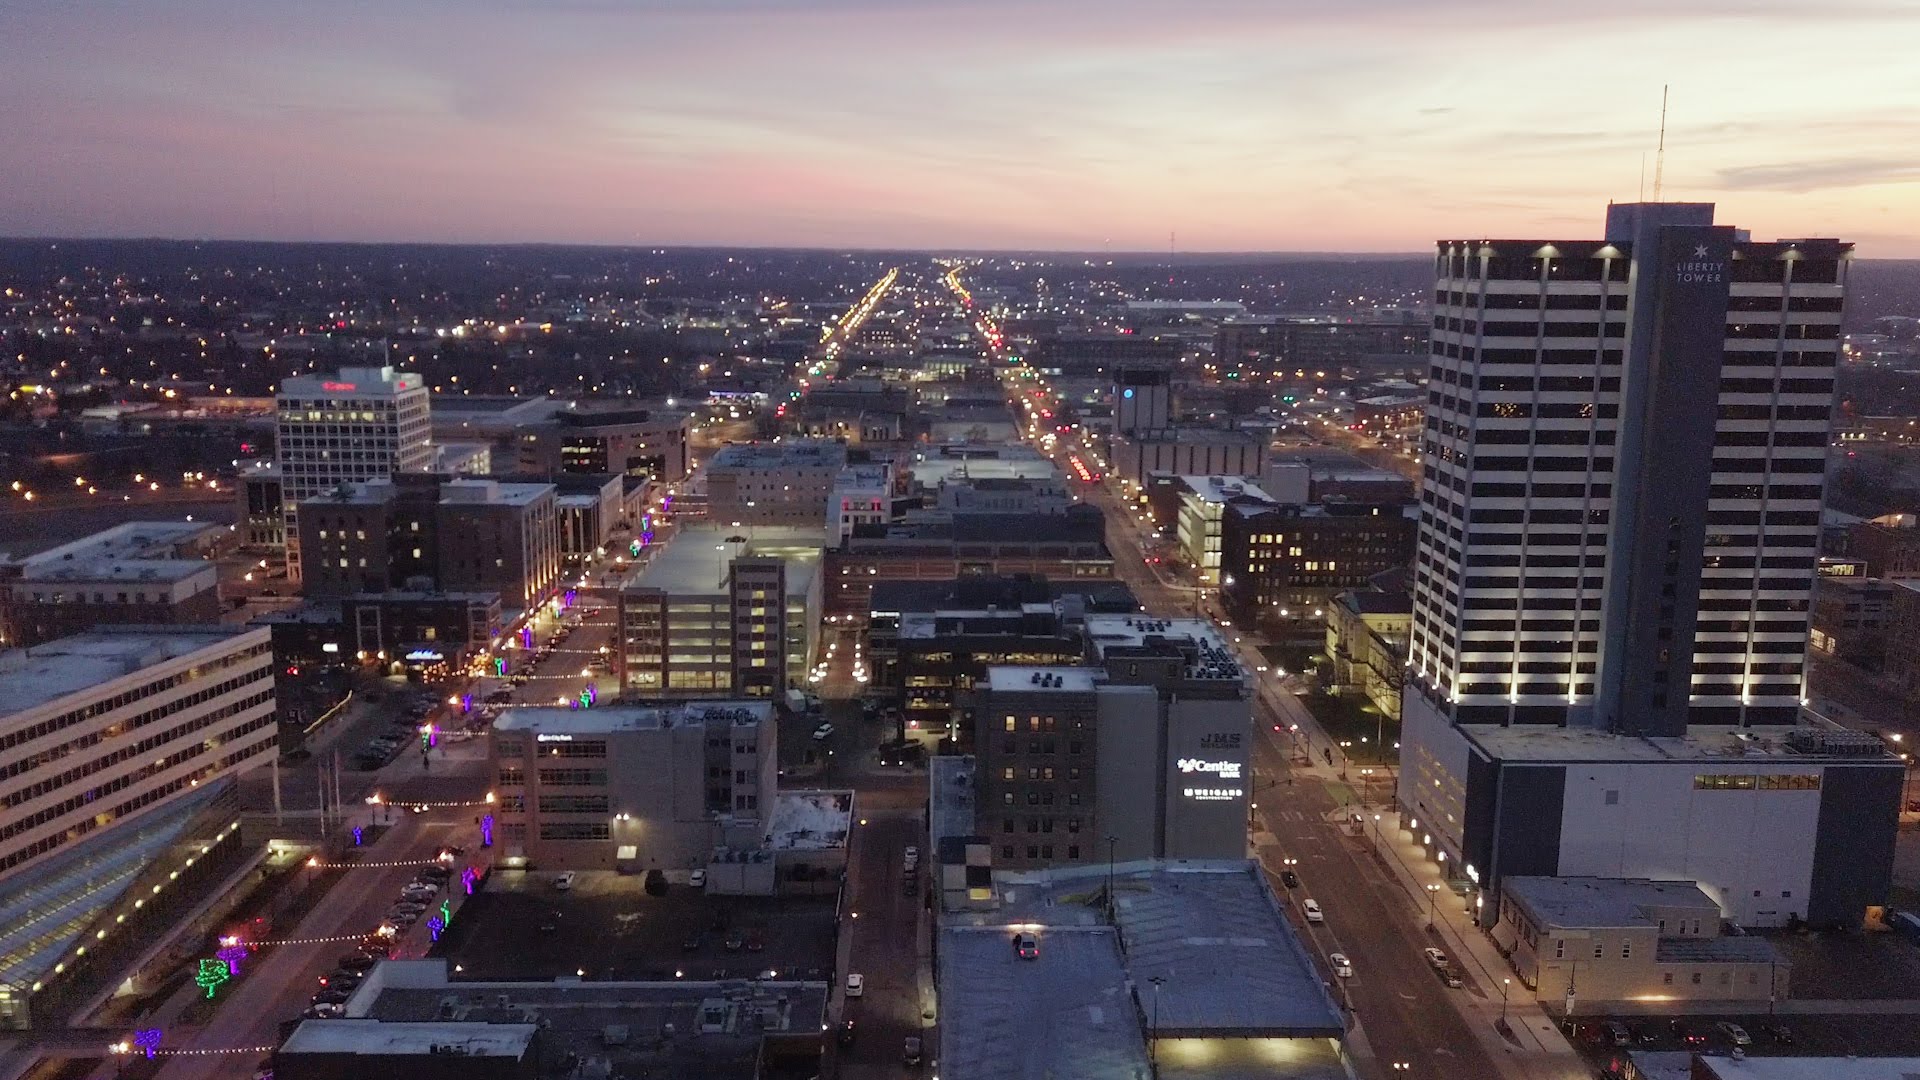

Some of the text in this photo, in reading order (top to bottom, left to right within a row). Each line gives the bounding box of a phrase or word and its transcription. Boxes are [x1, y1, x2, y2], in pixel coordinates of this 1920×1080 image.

[1677, 262, 1723, 271] LIBERTY
[1677, 273, 1721, 282] TOWER
[1201, 733, 1241, 743] JMS
[1195, 760, 1241, 771] Centier
